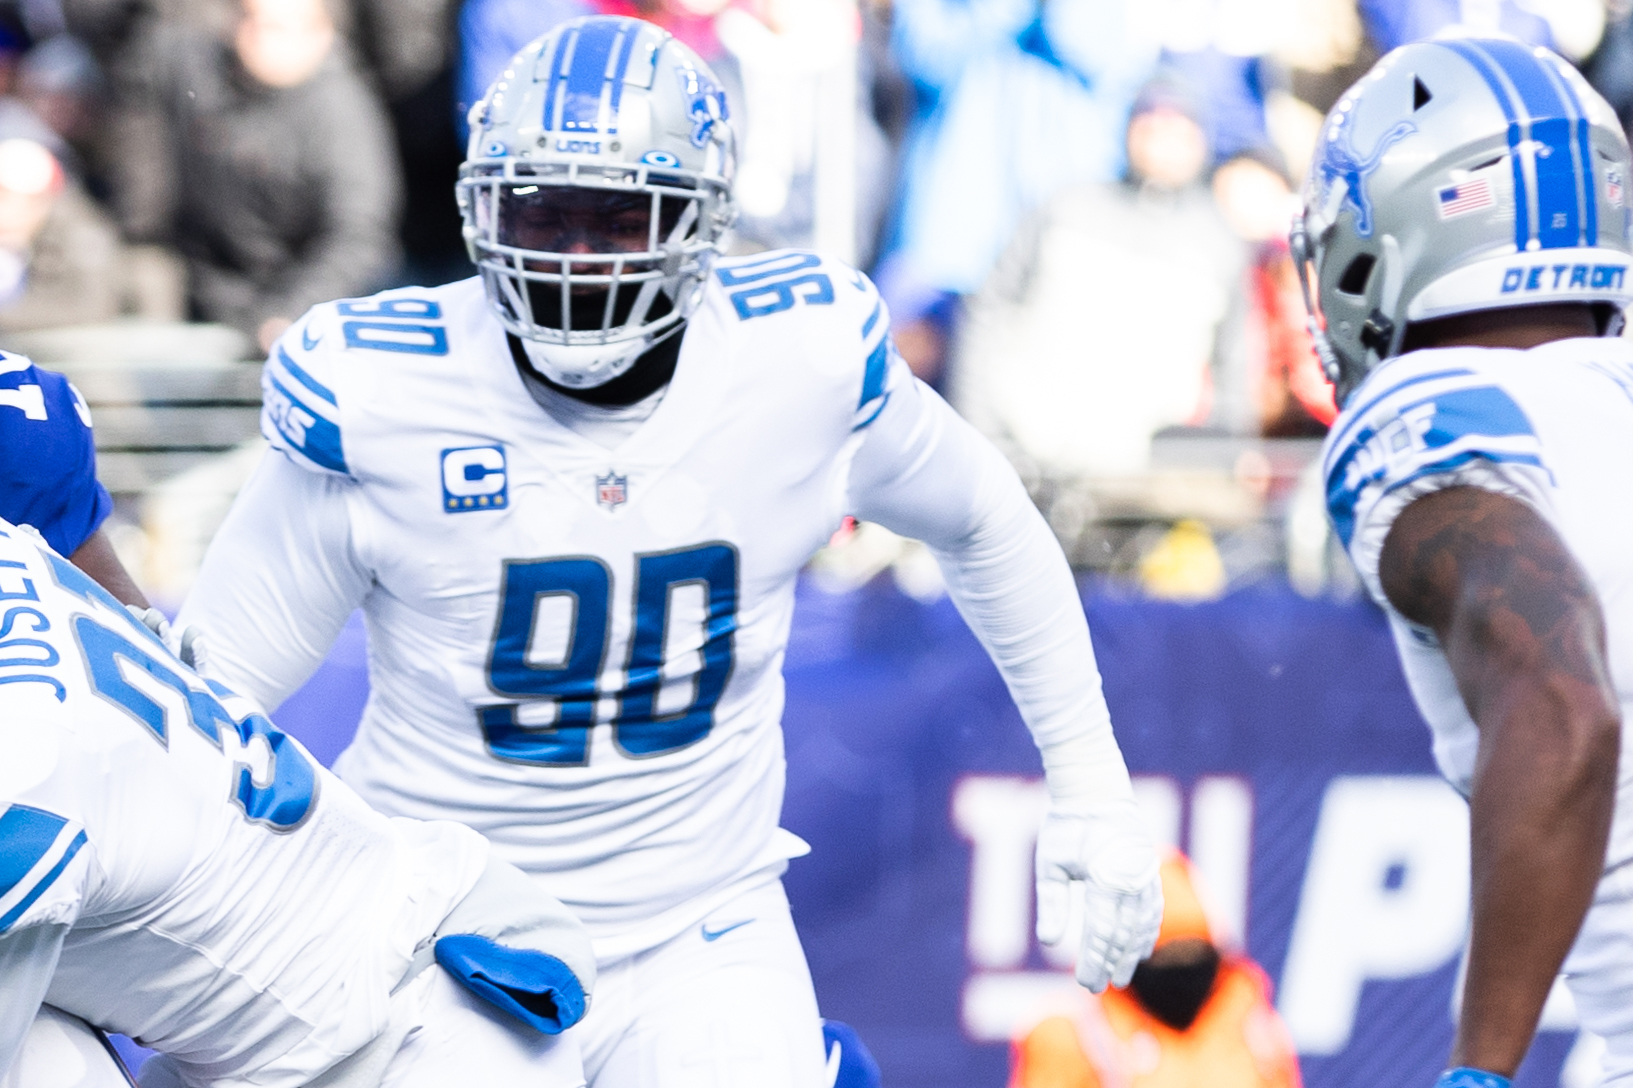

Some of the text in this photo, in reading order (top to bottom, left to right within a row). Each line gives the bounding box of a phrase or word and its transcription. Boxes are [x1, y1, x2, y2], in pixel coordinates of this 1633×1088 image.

[716, 253, 835, 321] 90
[1499, 263, 1628, 294] DETROIT
[336, 298, 450, 356] 90
[444, 448, 506, 497] C
[475, 539, 741, 768] 90
[35, 542, 322, 836] 31
